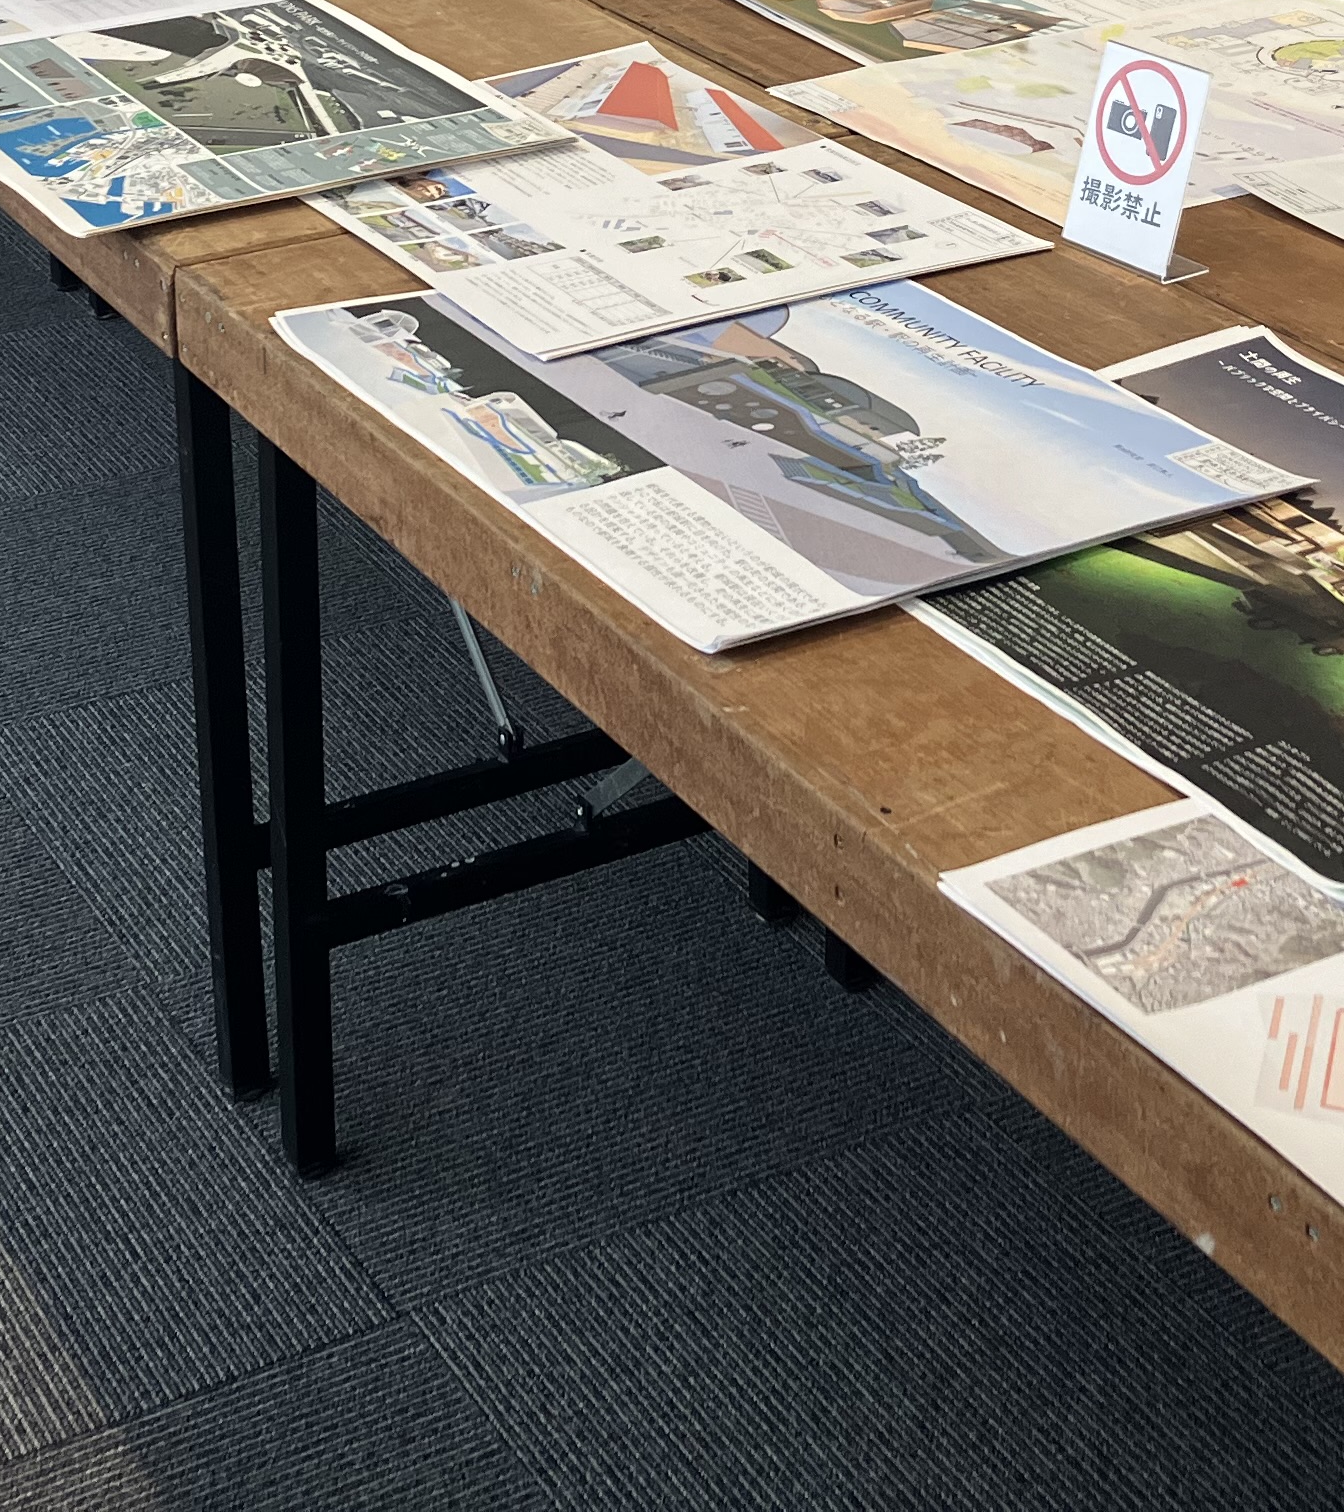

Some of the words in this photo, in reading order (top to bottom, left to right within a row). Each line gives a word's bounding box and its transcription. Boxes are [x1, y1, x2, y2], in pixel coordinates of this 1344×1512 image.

[1080, 175, 1161, 228] 撮影禁止
[849, 290, 968, 350] COMMUNITY
[957, 349, 1046, 388] FACILITY
